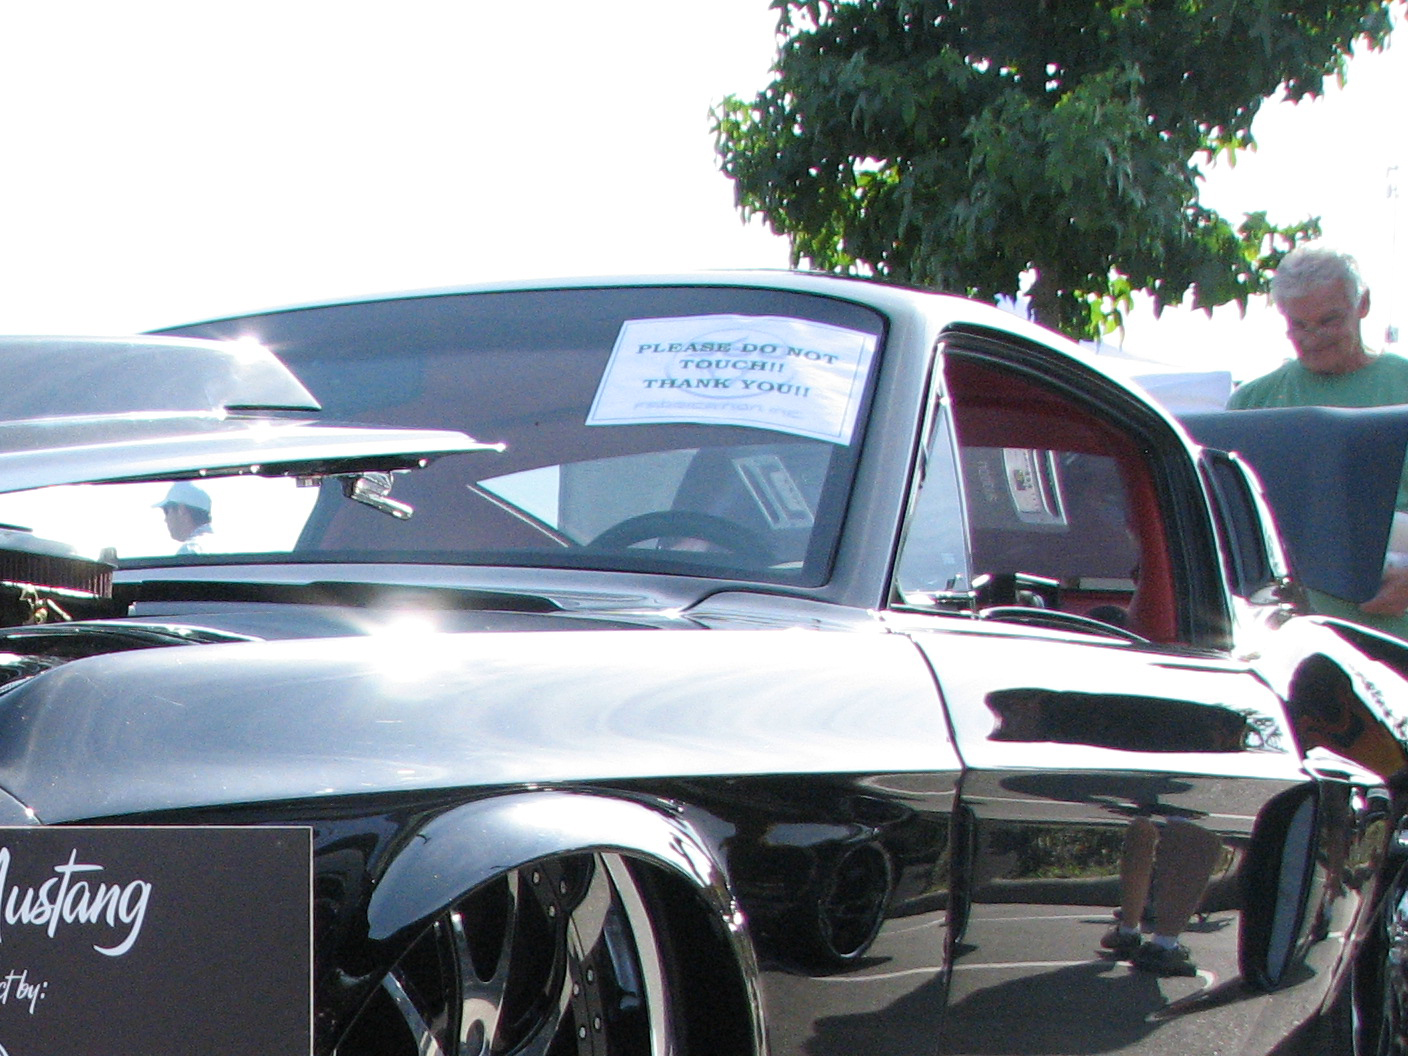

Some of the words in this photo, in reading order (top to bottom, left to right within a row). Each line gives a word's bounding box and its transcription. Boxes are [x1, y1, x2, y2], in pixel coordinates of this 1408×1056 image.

[637, 342, 731, 354] PLEASE
[741, 344, 777, 354] DO
[786, 347, 839, 364] NOT
[679, 359, 784, 373] TOUCH!!
[643, 378, 731, 388] THANK
[741, 380, 810, 397] YOU!!
[15, 969, 48, 1014] by:
